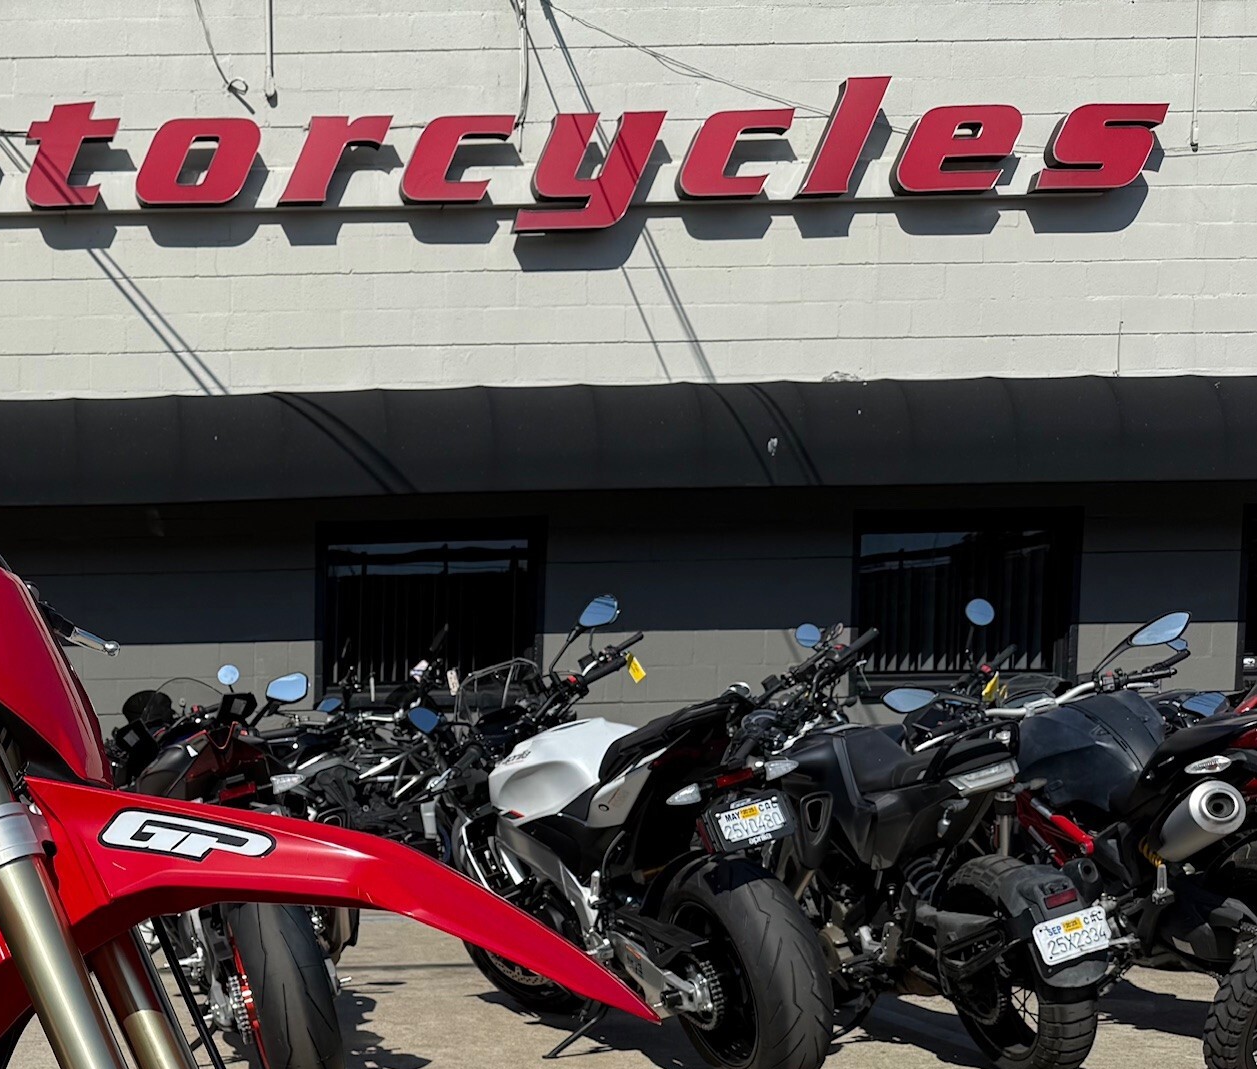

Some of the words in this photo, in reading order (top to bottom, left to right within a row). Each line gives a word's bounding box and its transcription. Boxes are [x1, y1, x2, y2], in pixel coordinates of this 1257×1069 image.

[724, 811, 782, 839] 25V0480
[725, 812, 741, 822] MAY
[100, 809, 274, 859] GP
[1047, 925, 1062, 937] SEP
[1047, 924, 1107, 955] 25X2334
